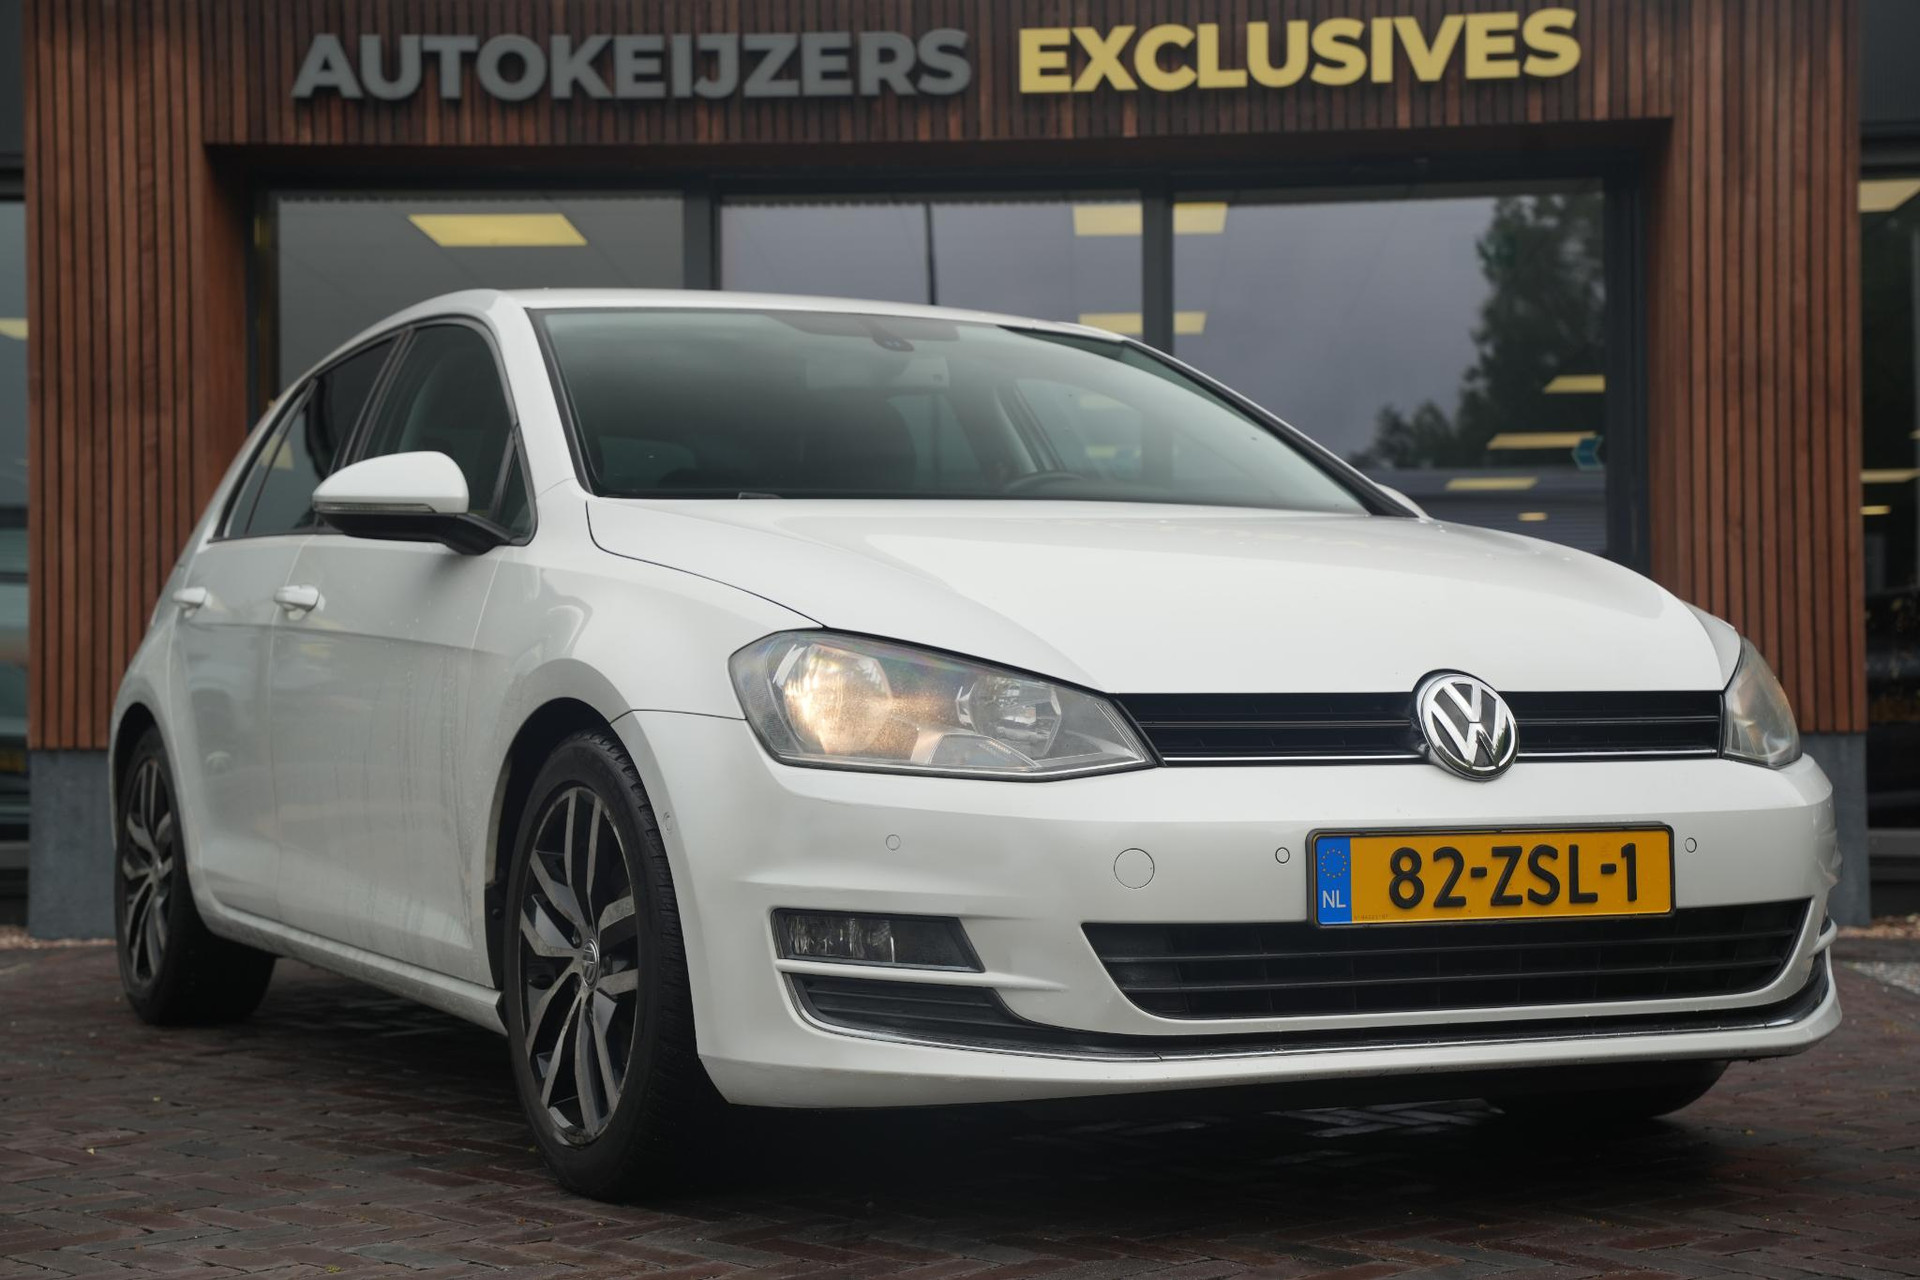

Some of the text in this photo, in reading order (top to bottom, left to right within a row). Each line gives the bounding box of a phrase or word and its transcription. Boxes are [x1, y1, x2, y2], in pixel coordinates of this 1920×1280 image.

[292, 8, 1581, 101] AUTOKEIJZERS EXCLUSIVES
[1423, 676, 1516, 775] VW
[1322, 890, 1346, 909] NL
[1388, 842, 1638, 909] 82-ZSL-1
